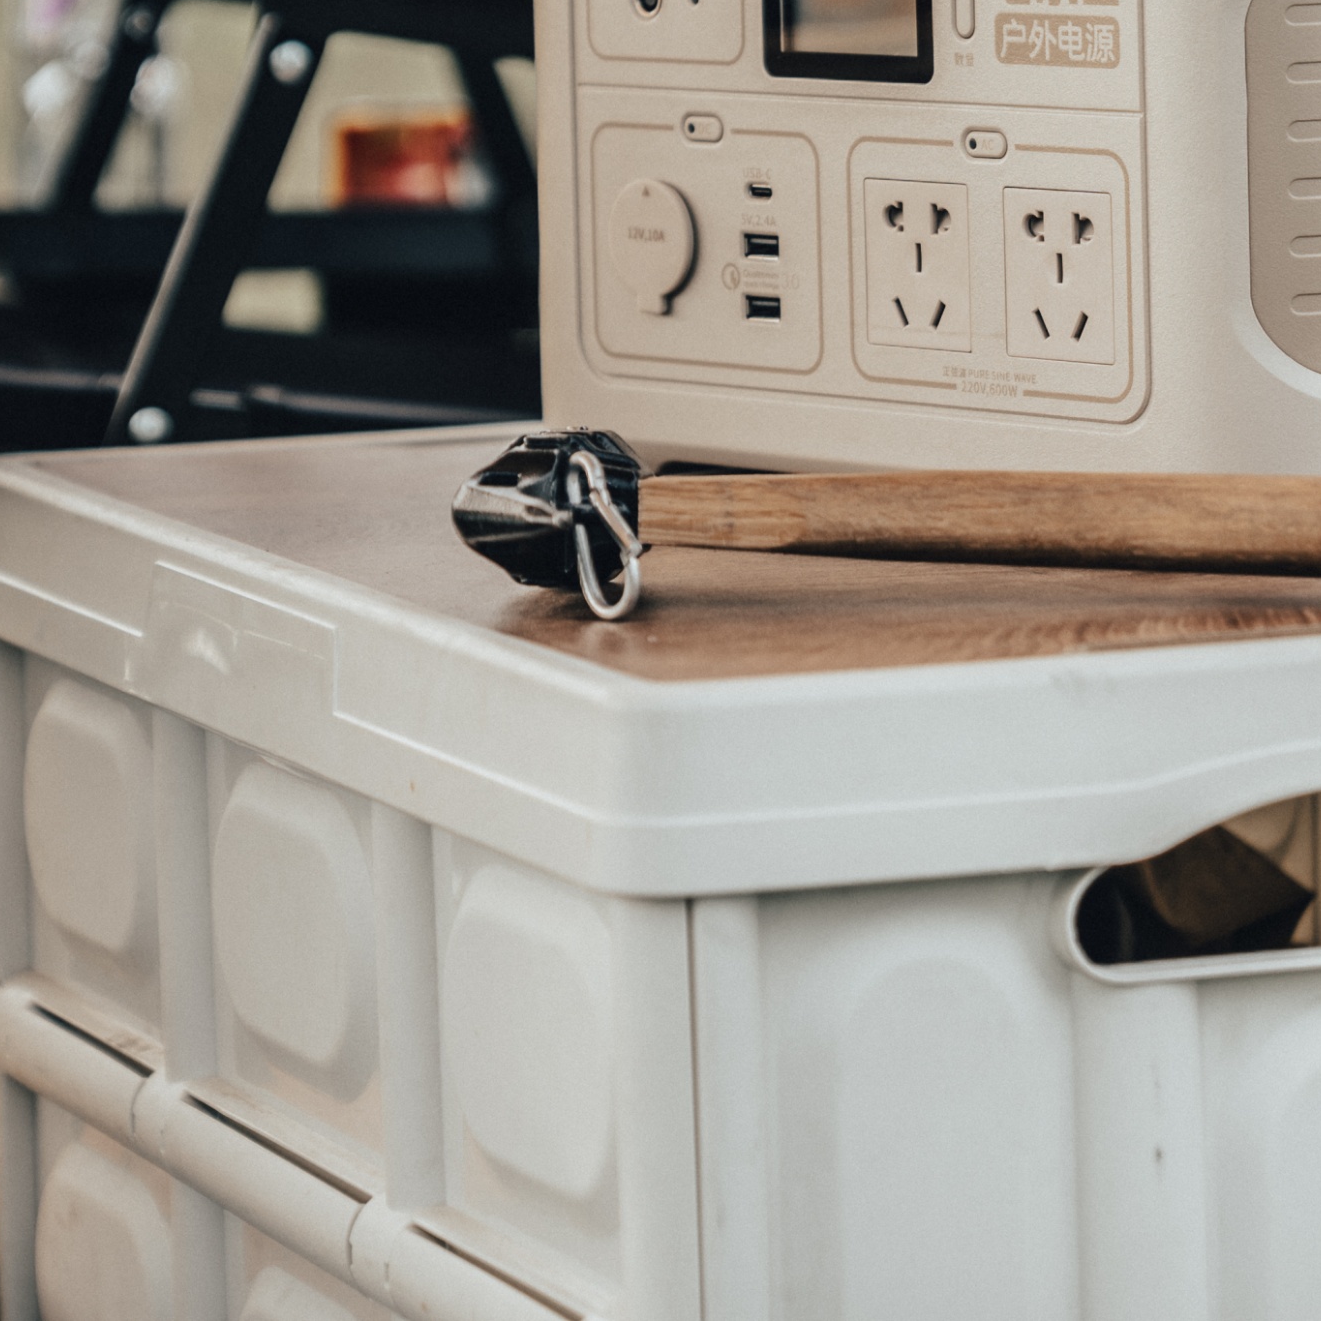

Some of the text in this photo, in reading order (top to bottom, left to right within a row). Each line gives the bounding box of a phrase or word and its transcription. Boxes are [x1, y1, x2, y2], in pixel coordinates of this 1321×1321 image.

[1000, 18, 1115, 63] 户外电源
[981, 138, 995, 151] AC
[742, 167, 773, 180] USB-C
[968, 369, 989, 379] PURE
[991, 371, 1011, 382] SINE
[1014, 373, 1037, 384] WAVE
[961, 380, 1018, 398] 220V,600W
